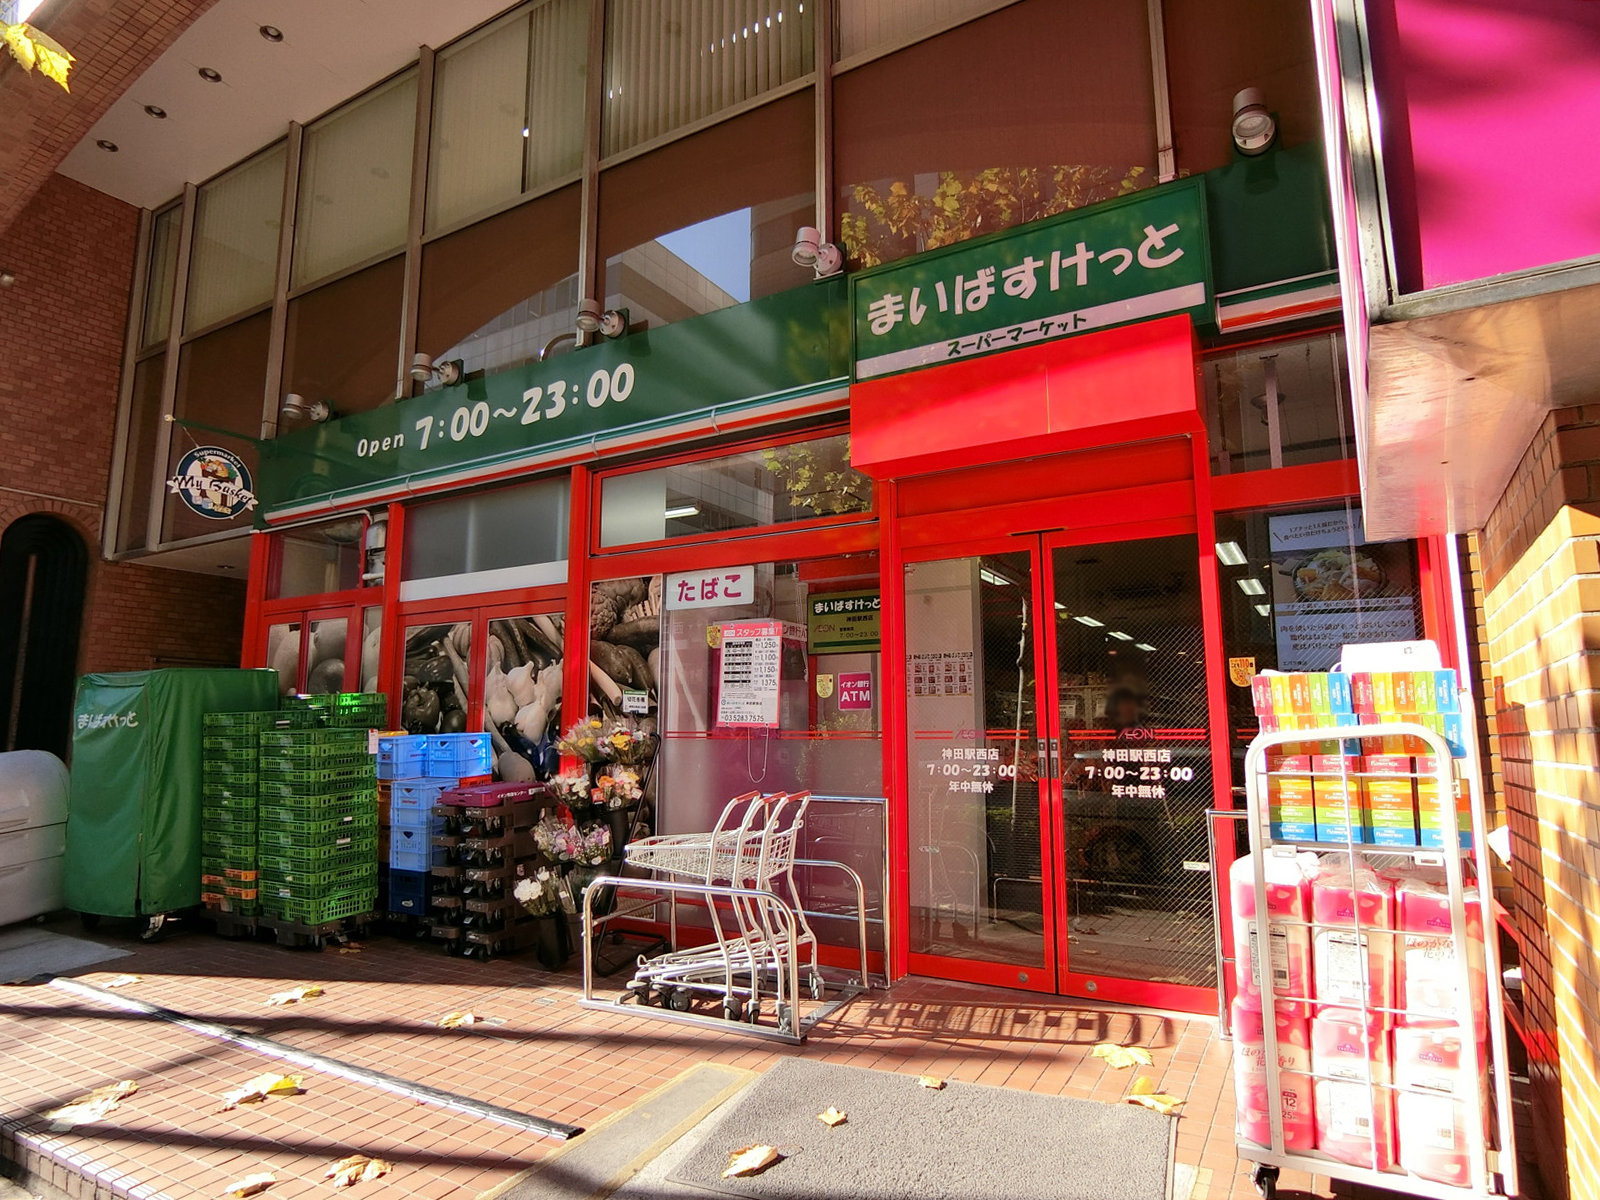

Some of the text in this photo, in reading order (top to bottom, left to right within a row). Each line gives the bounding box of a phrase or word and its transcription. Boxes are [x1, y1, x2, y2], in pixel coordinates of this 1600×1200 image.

[867, 223, 1184, 336] まいばすけっと
[947, 314, 1087, 356] スーパーマーケット
[357, 433, 404, 457] Open
[194, 449, 242, 468] Supermarket
[173, 475, 253, 504] My Basket
[677, 574, 742, 602] たばこ
[814, 598, 881, 614] まいばすけっと
[841, 680, 869, 688] イオン銀行
[841, 691, 870, 702] ATM
[1118, 728, 1155, 740] AEON
[942, 748, 999, 761] 神田駅西店
[1102, 749, 1171, 763] 神田駅西店
[948, 781, 994, 793] 年中無休
[1111, 784, 1166, 798] 年中無休
[1284, 1098, 1296, 1107] 12
